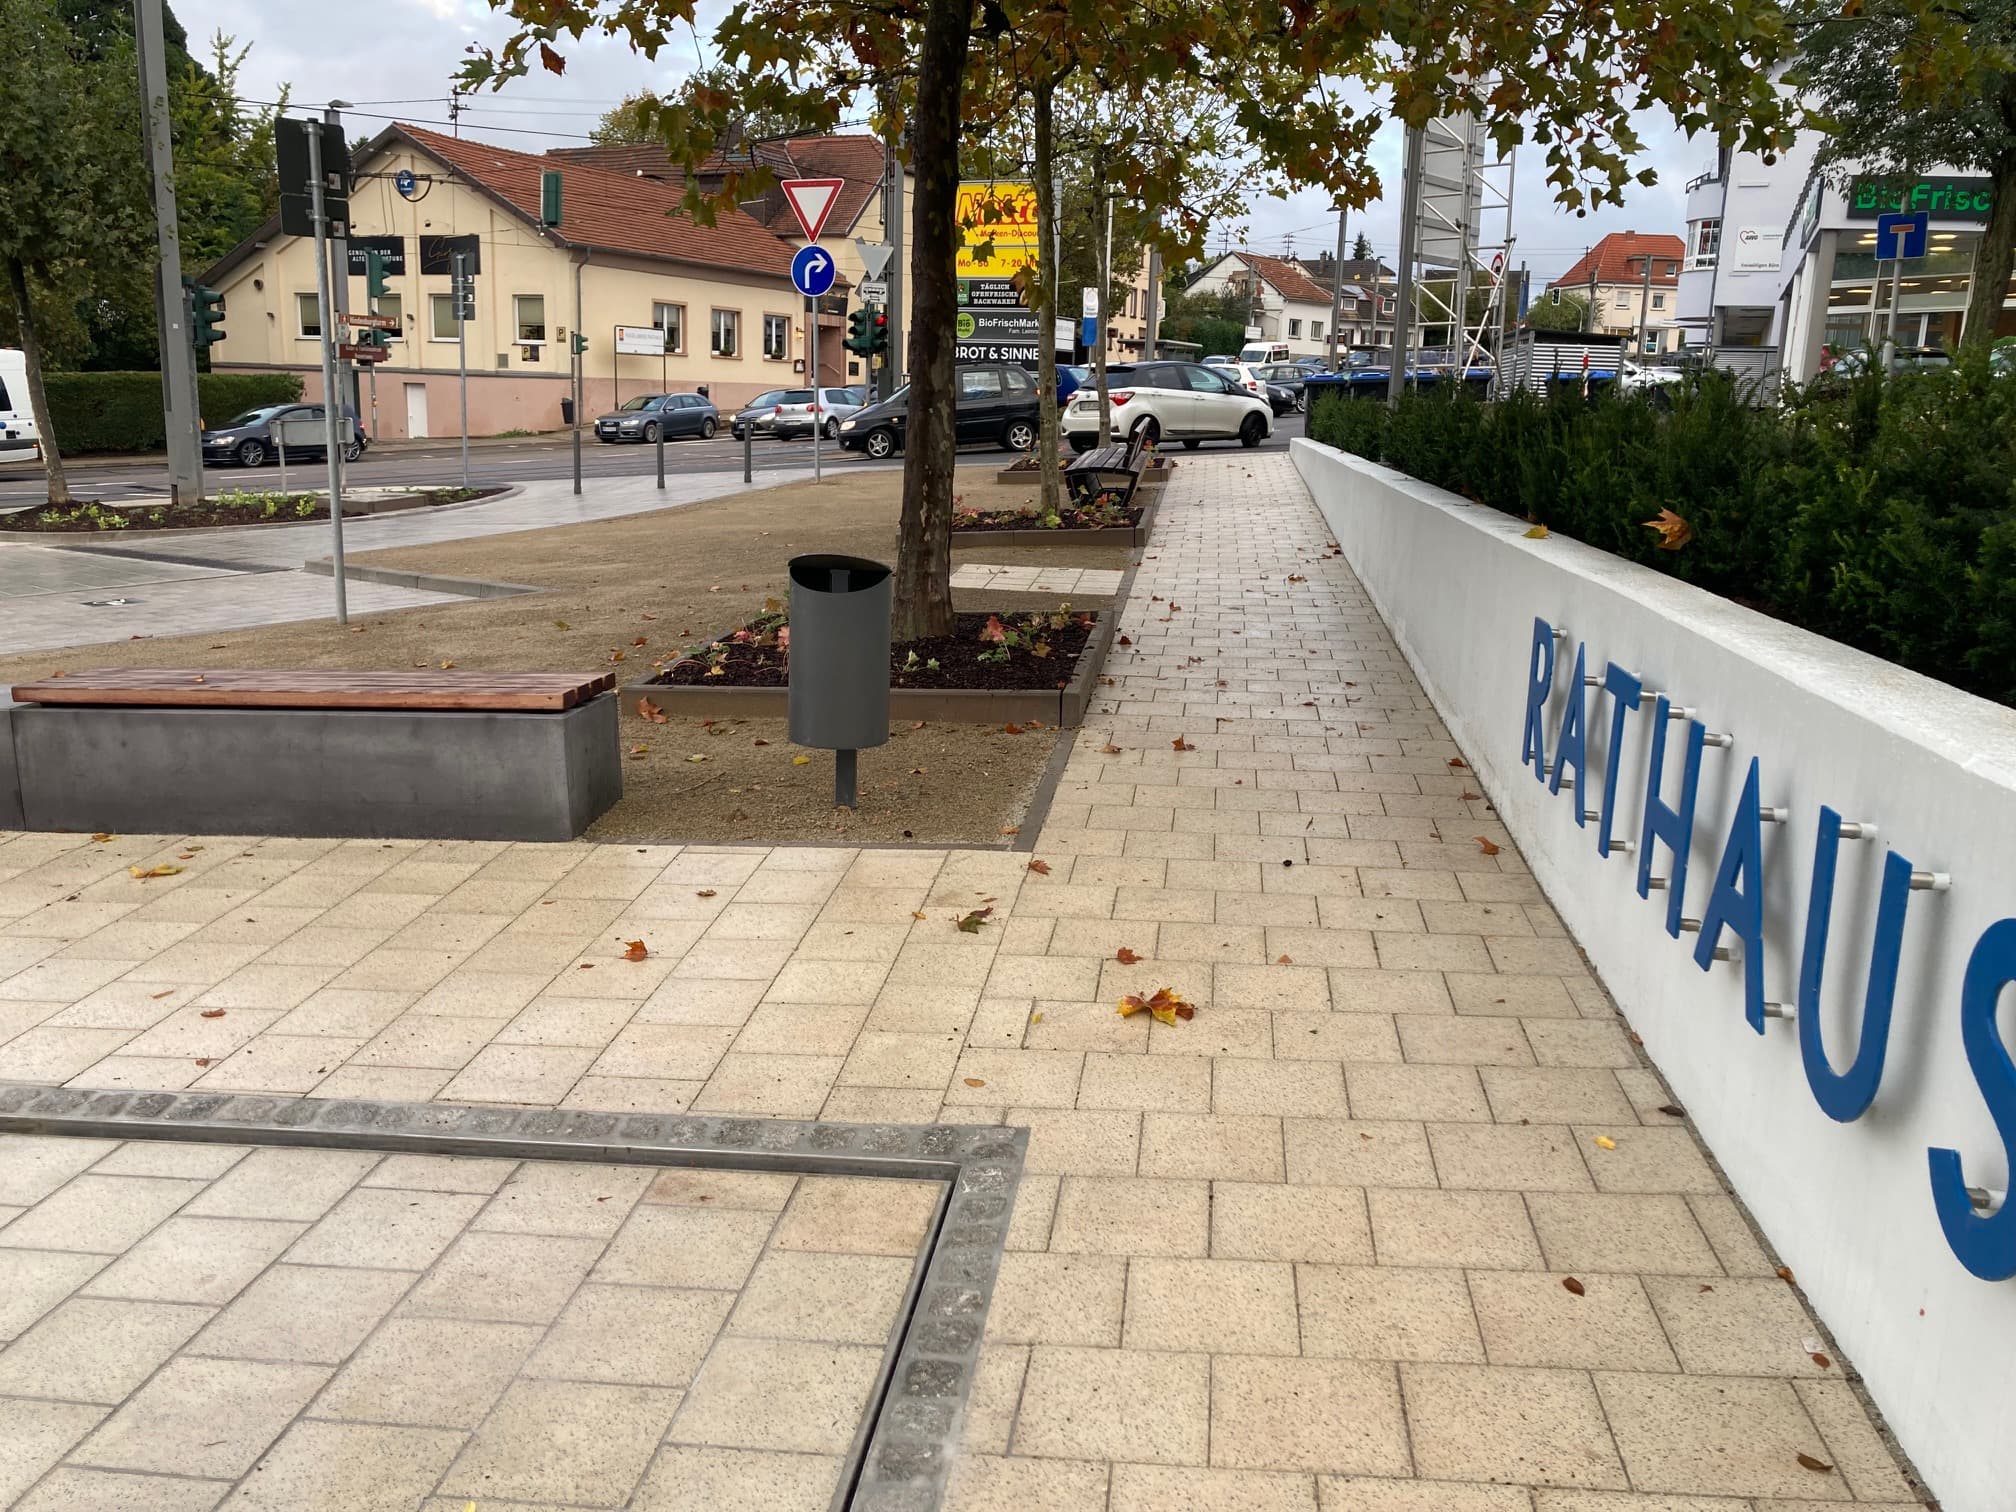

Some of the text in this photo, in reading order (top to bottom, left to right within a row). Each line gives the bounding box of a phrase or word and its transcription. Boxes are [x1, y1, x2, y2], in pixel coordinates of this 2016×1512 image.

[958, 259, 971, 267] Mo
[978, 318, 1040, 328] BioFrischMark
[989, 346, 998, 359] &
[1521, 616, 2016, 1282] RATHAUS
